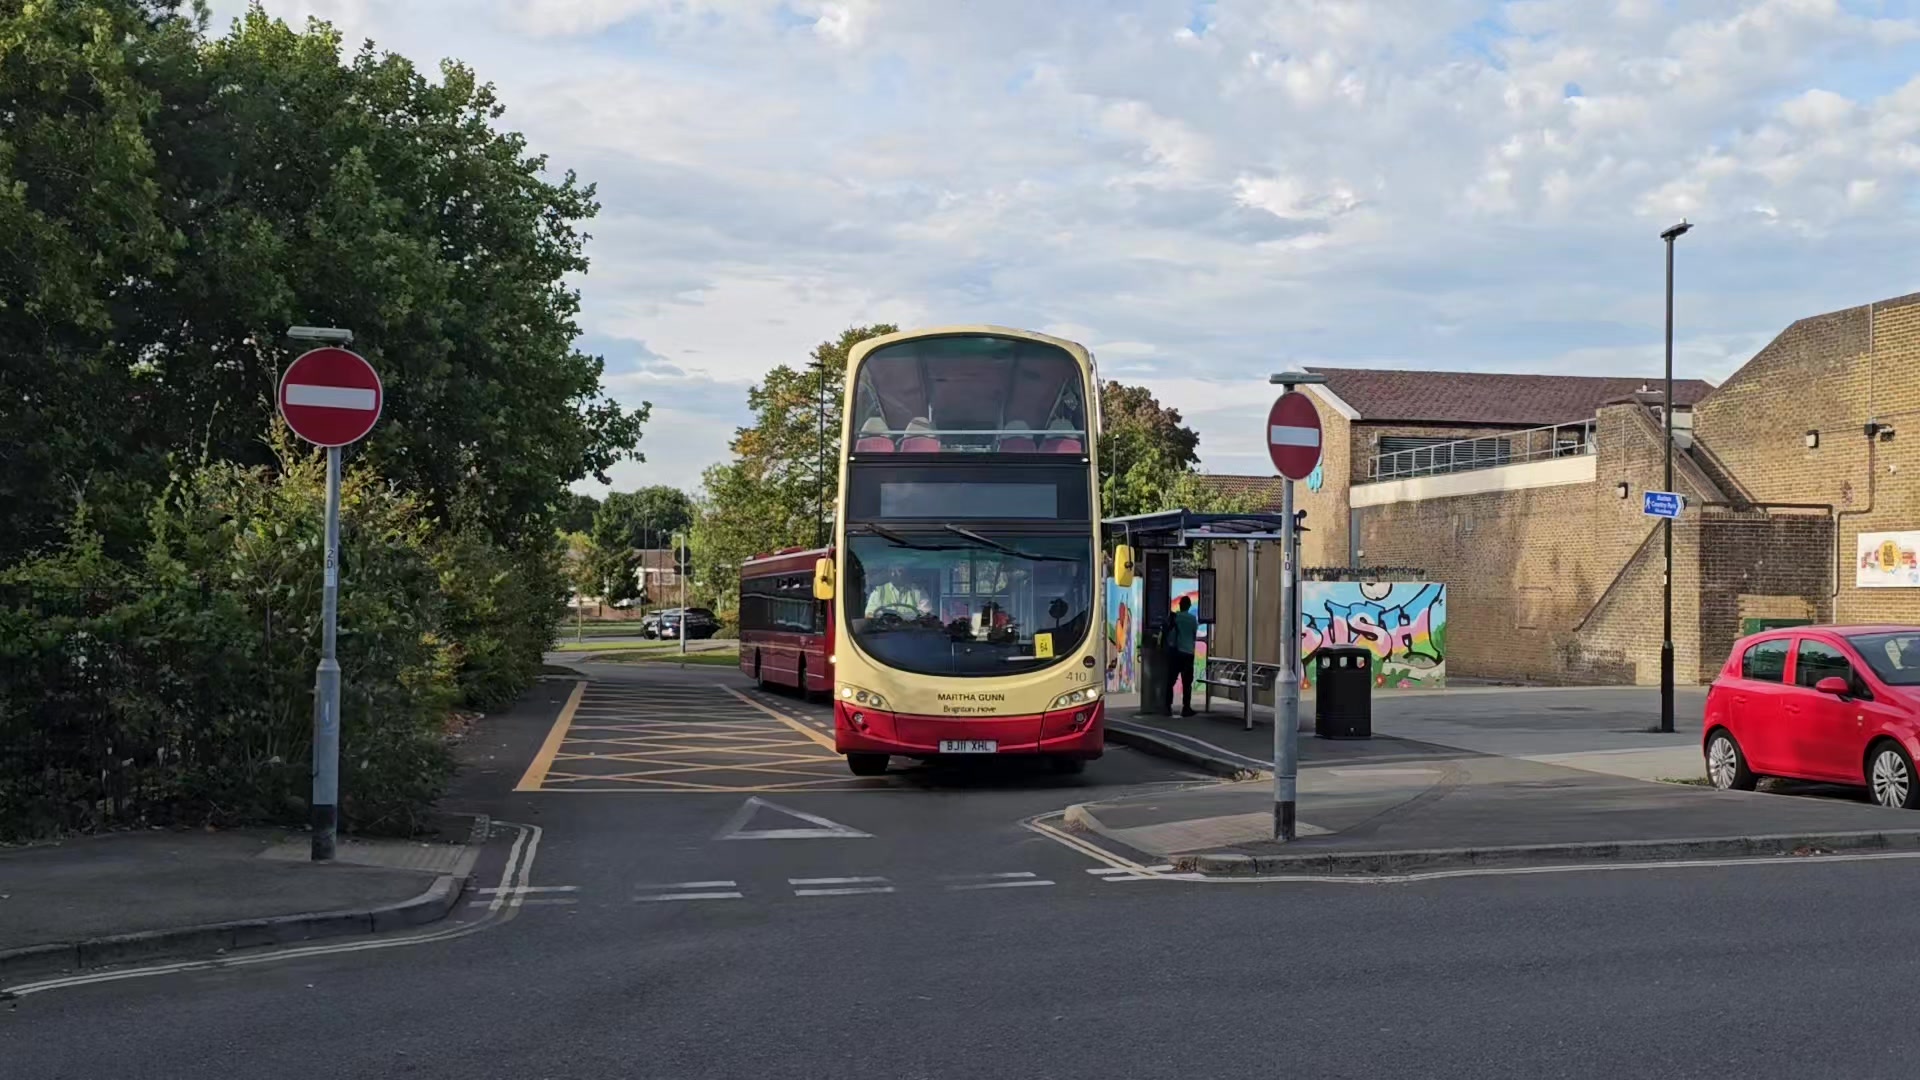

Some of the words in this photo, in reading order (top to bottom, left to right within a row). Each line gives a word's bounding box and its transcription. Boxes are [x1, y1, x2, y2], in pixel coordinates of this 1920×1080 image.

[1066, 672, 1087, 682] 410
[937, 693, 976, 701] MARTHA
[978, 693, 1005, 701] GUNN
[971, 741, 991, 751] XHL
